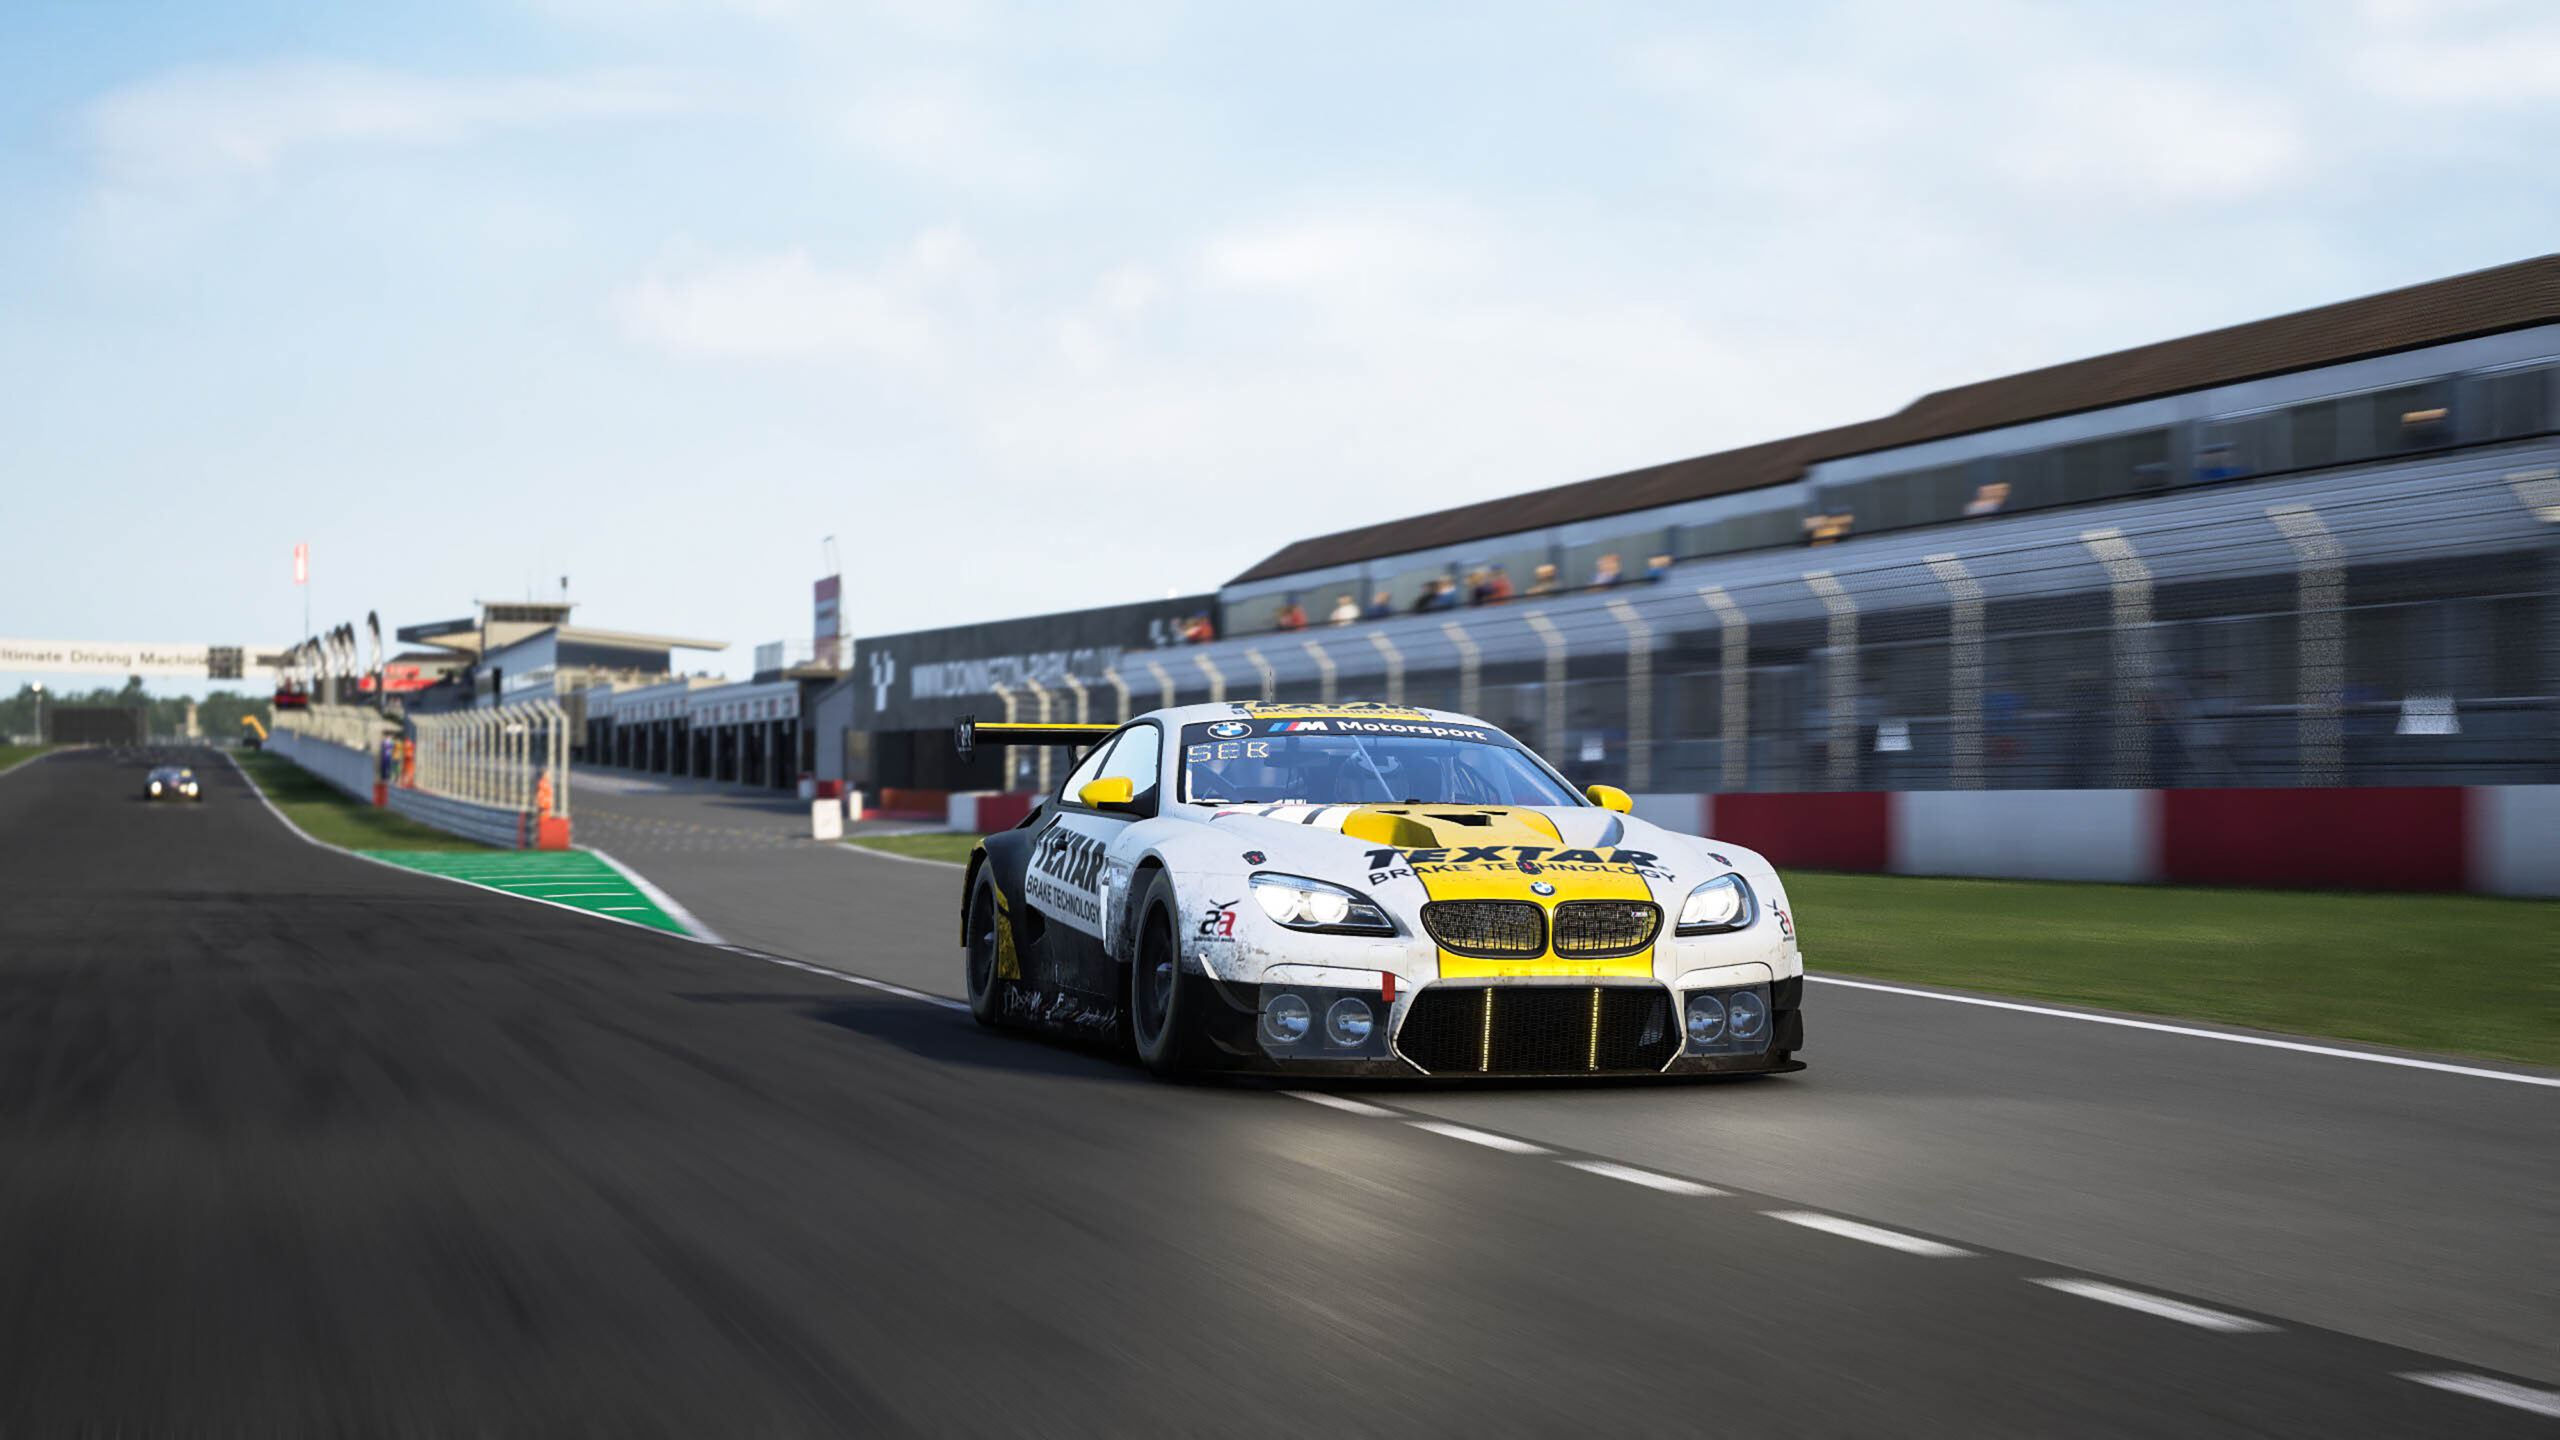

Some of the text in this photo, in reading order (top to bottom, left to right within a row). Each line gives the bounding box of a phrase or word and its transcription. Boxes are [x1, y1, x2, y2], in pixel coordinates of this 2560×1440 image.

[2, 648, 62, 663] ltimate
[70, 649, 131, 668] Driving
[1336, 720, 1488, 741] Motorsport
[1364, 845, 1659, 871] TEXTAR
[1367, 862, 1676, 886] BRAKE TEHNOLOGY
[1026, 874, 1101, 926] BRAKE TECHNOLOGY
